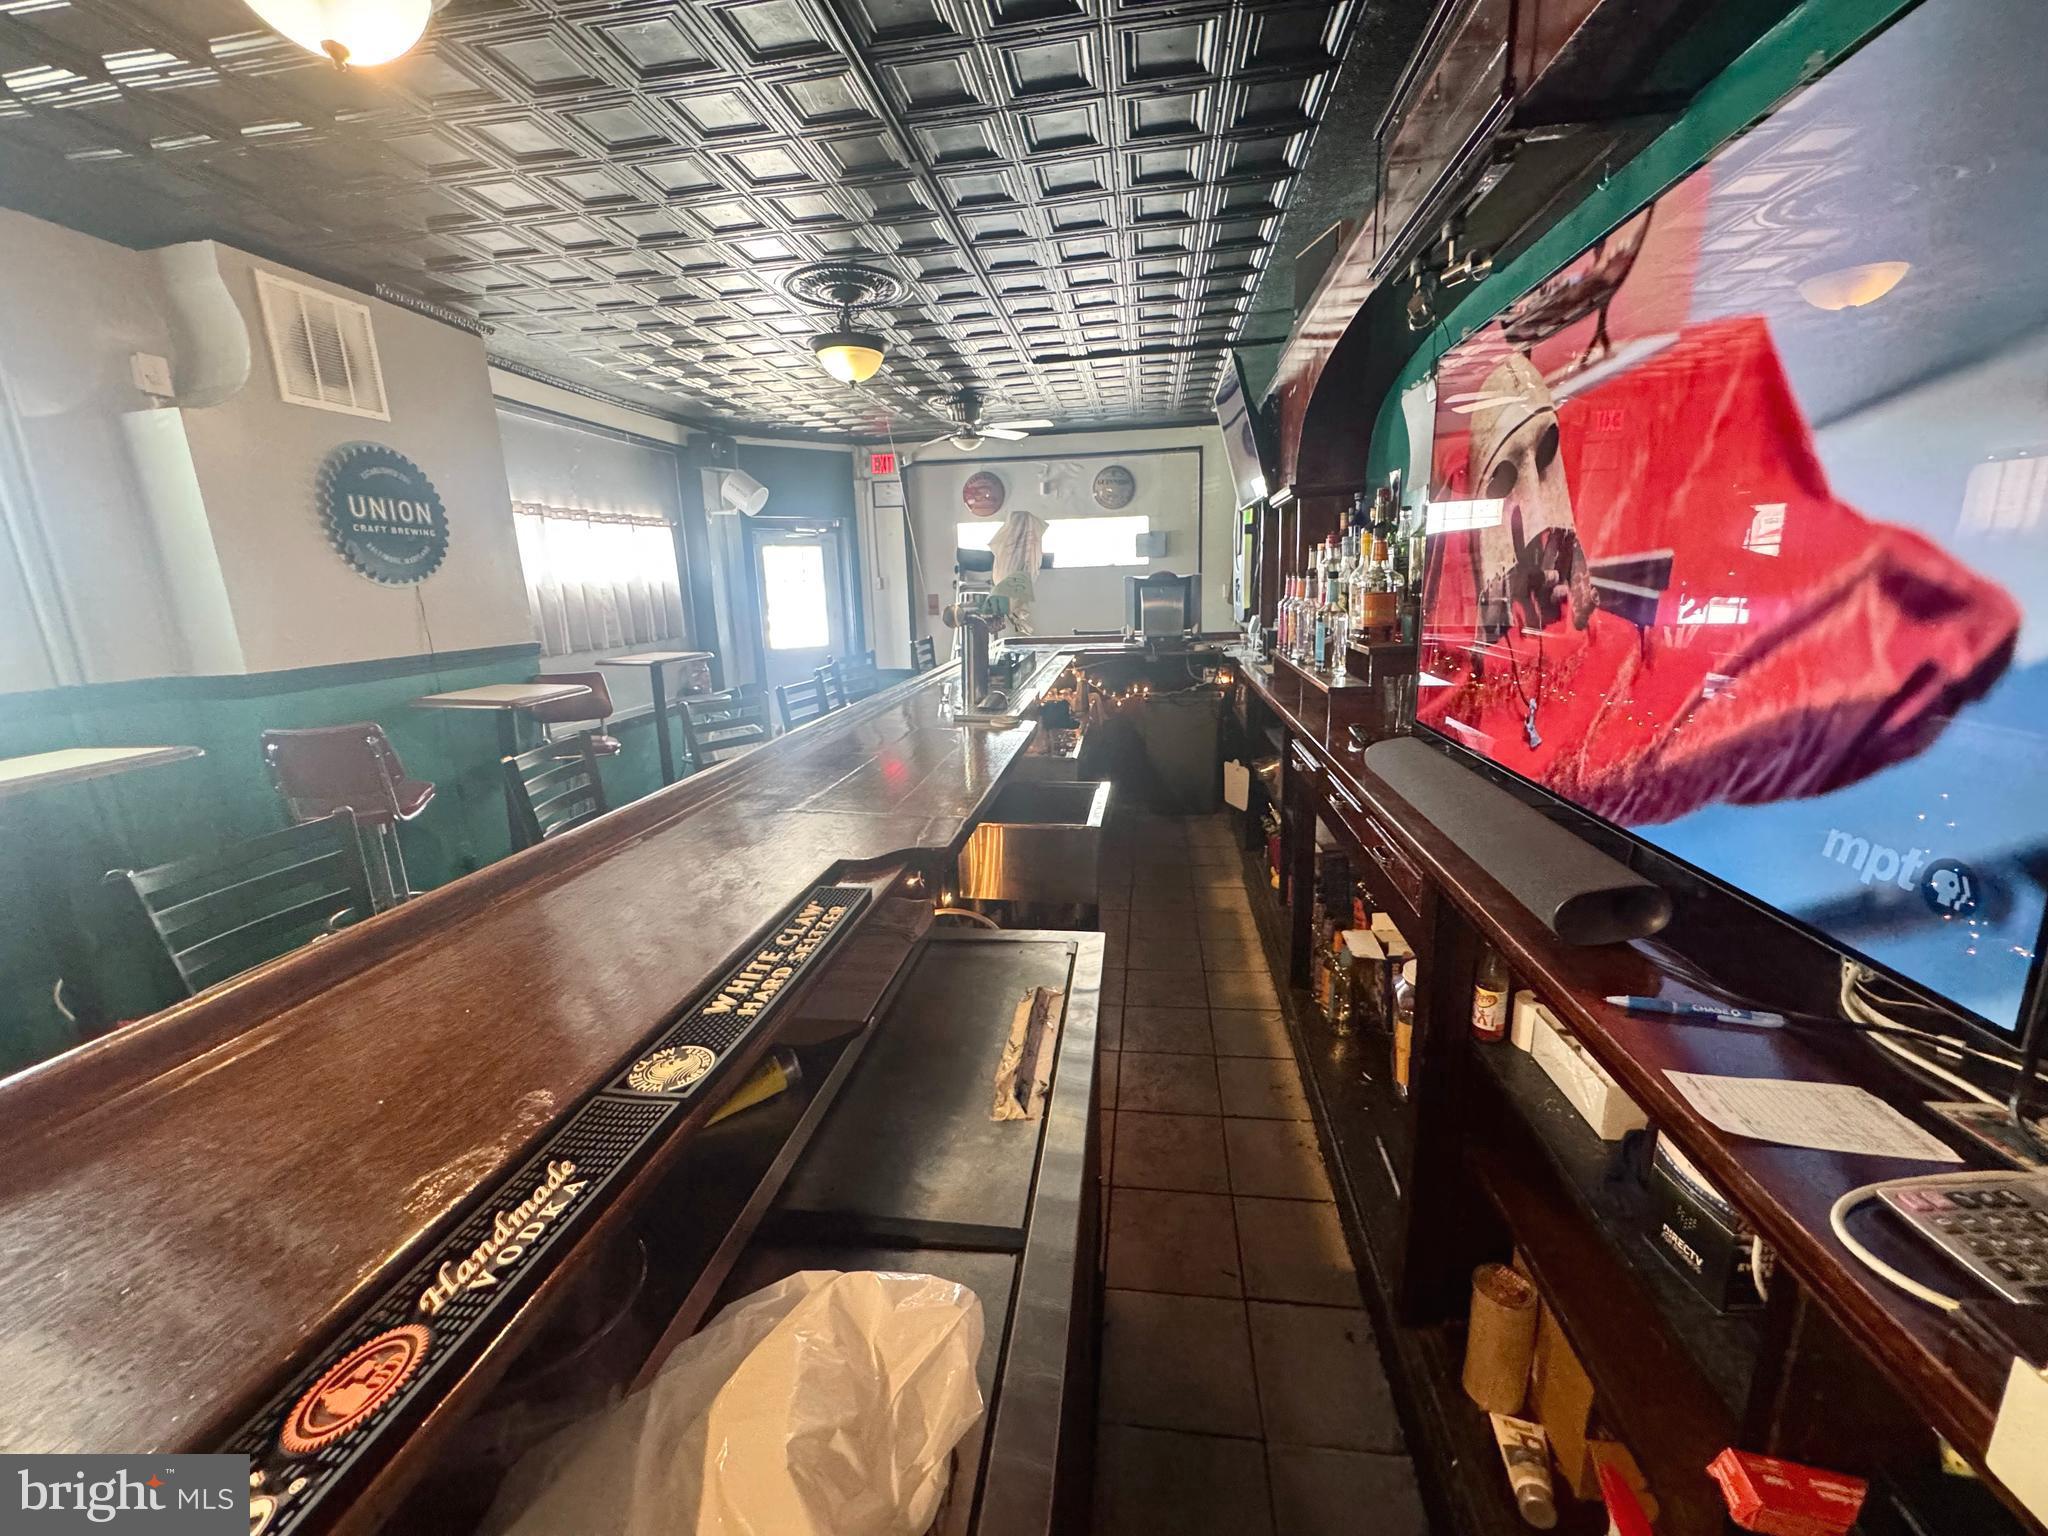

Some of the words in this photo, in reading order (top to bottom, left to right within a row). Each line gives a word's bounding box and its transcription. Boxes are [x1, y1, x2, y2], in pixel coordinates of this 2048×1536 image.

[871, 453, 895, 474] EXIT
[347, 494, 433, 525] UNION
[352, 524, 387, 534] CRAFT
[391, 525, 437, 537] BREWING
[1822, 827, 1926, 892] mpt
[703, 949, 785, 1016] WHITE
[775, 901, 825, 947] CLAW
[736, 965, 793, 1016] HARD
[787, 905, 848, 961] SELTZER
[1691, 1003, 1730, 1016] CHASE
[418, 1159, 577, 1314] Handmade
[468, 1179, 588, 1291] VODKA
[1662, 1222, 1705, 1267] DIRECTV
